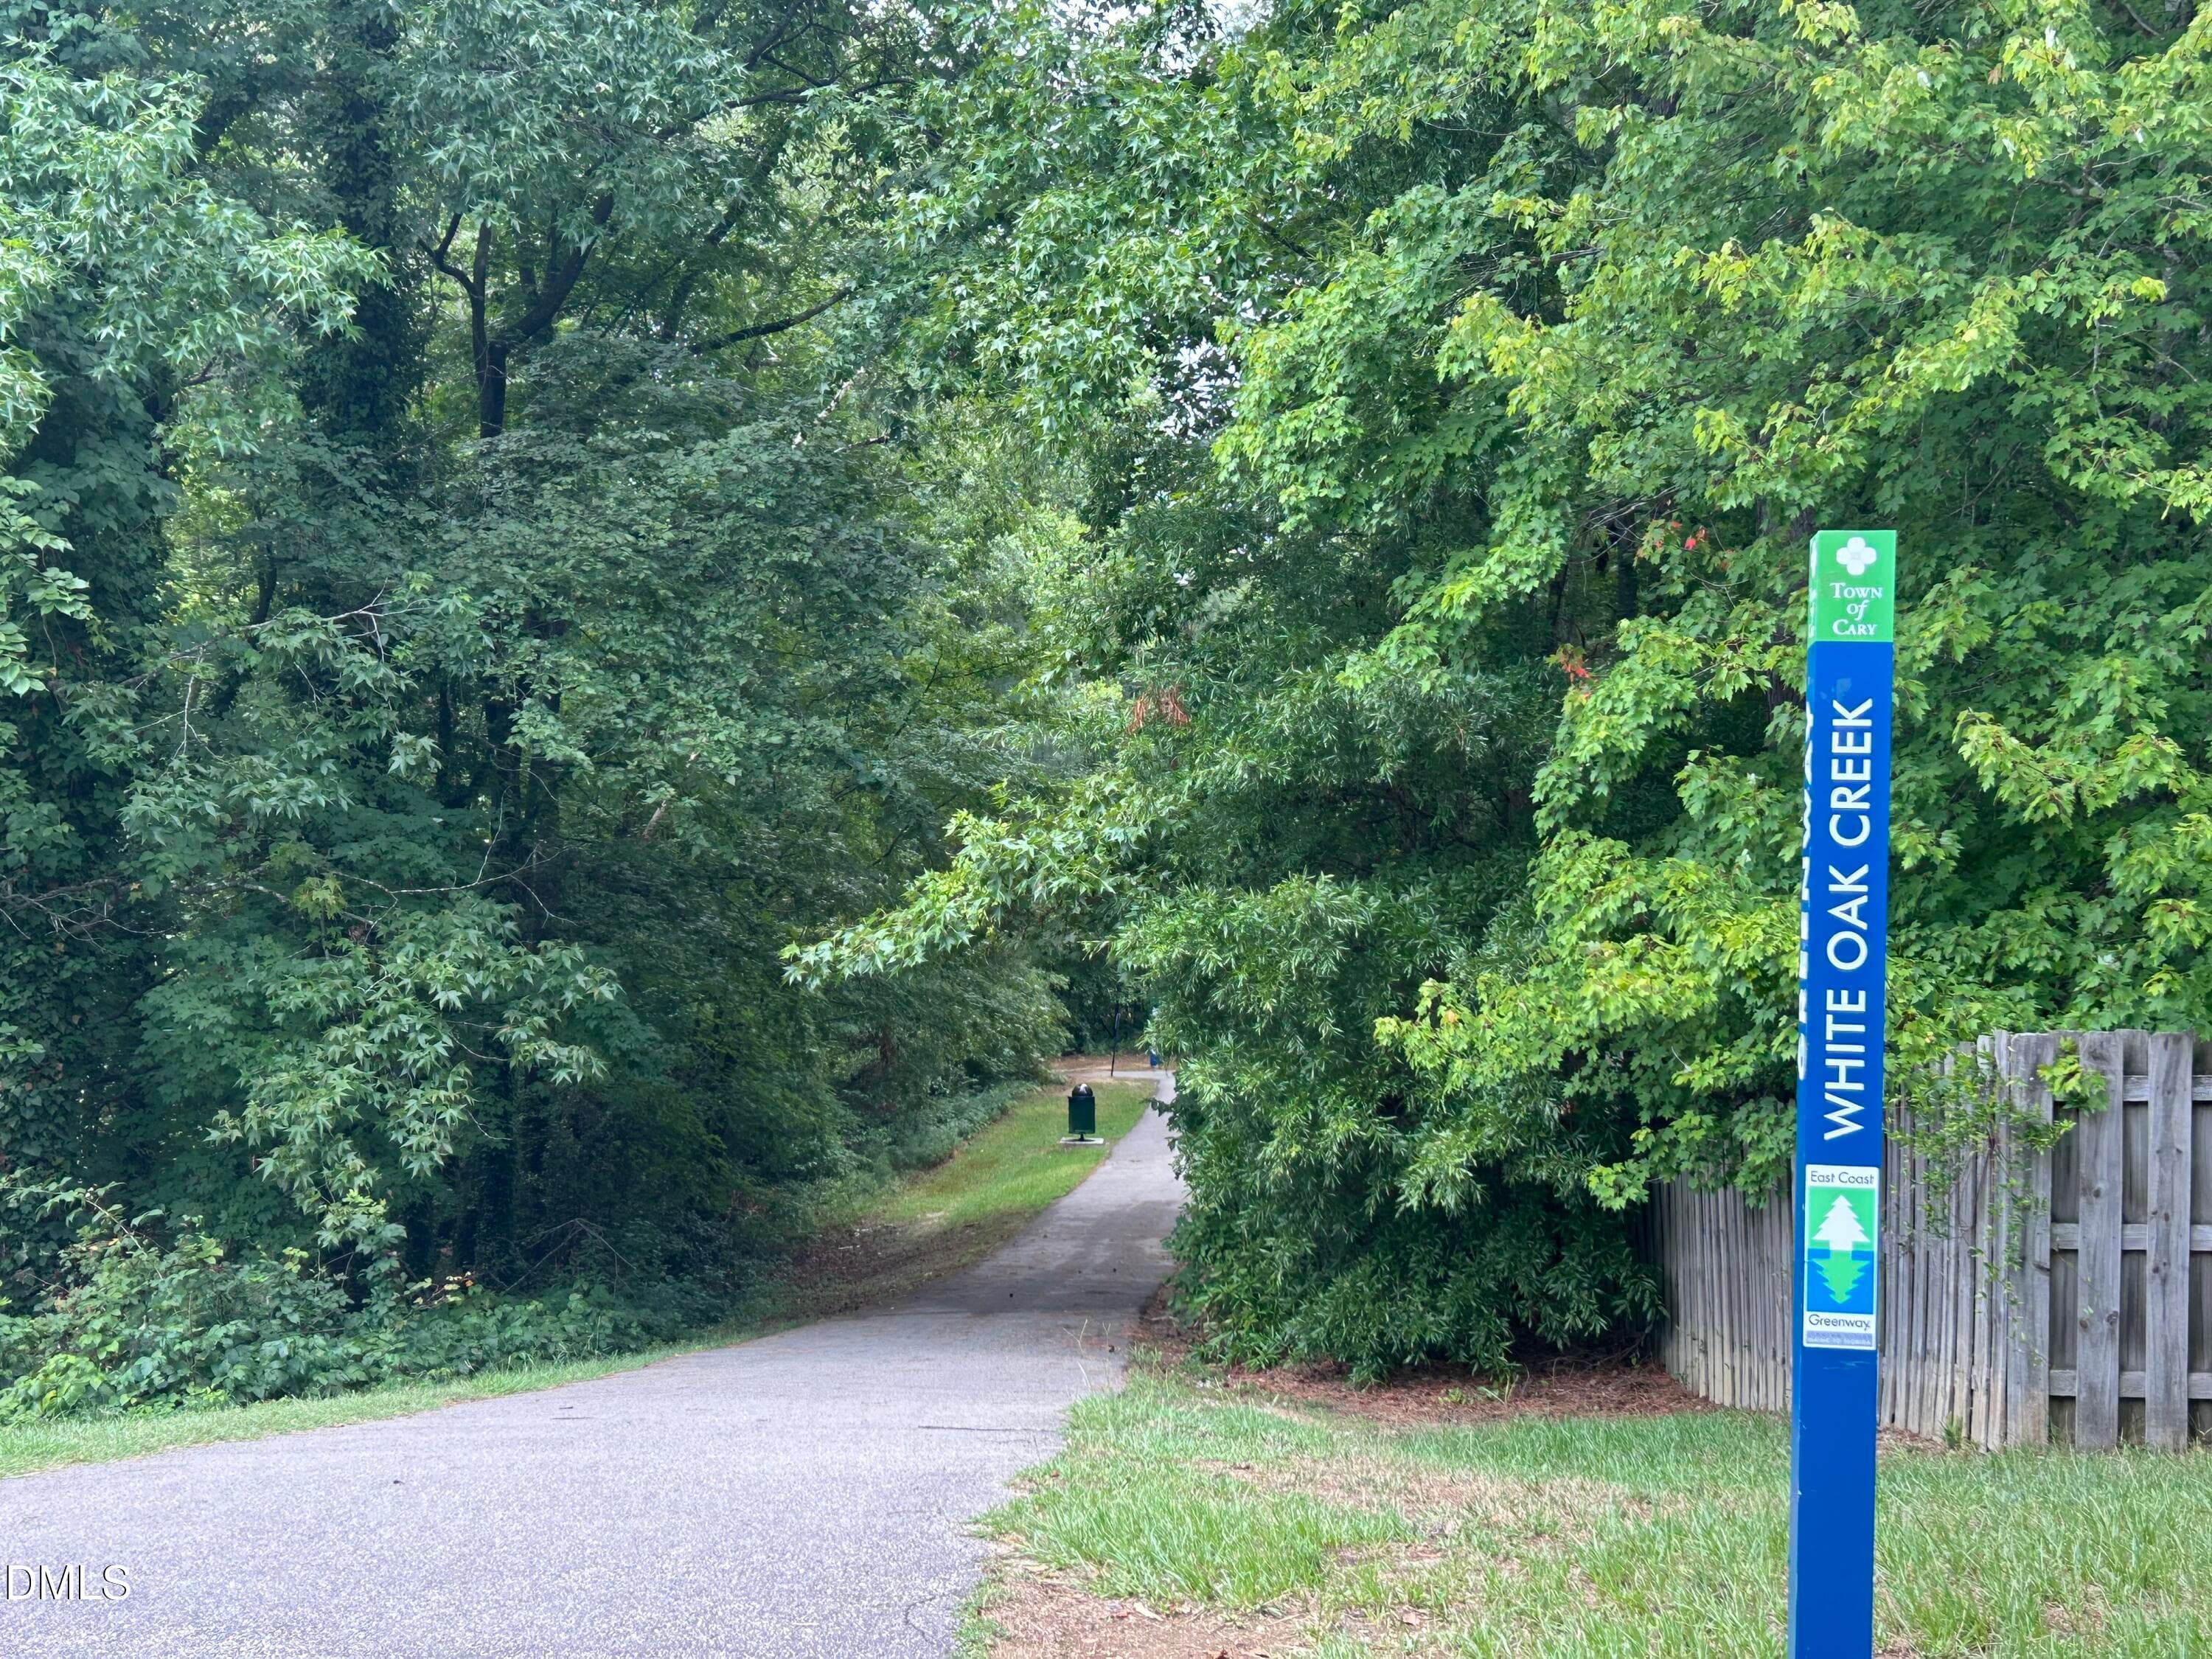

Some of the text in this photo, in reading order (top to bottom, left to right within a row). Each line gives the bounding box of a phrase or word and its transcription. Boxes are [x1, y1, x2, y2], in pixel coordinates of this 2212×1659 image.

[1846, 599, 1870, 621] of
[1823, 698, 1874, 1141] WHITE OAK CREEK
[1810, 1170, 1874, 1185] East Coast
